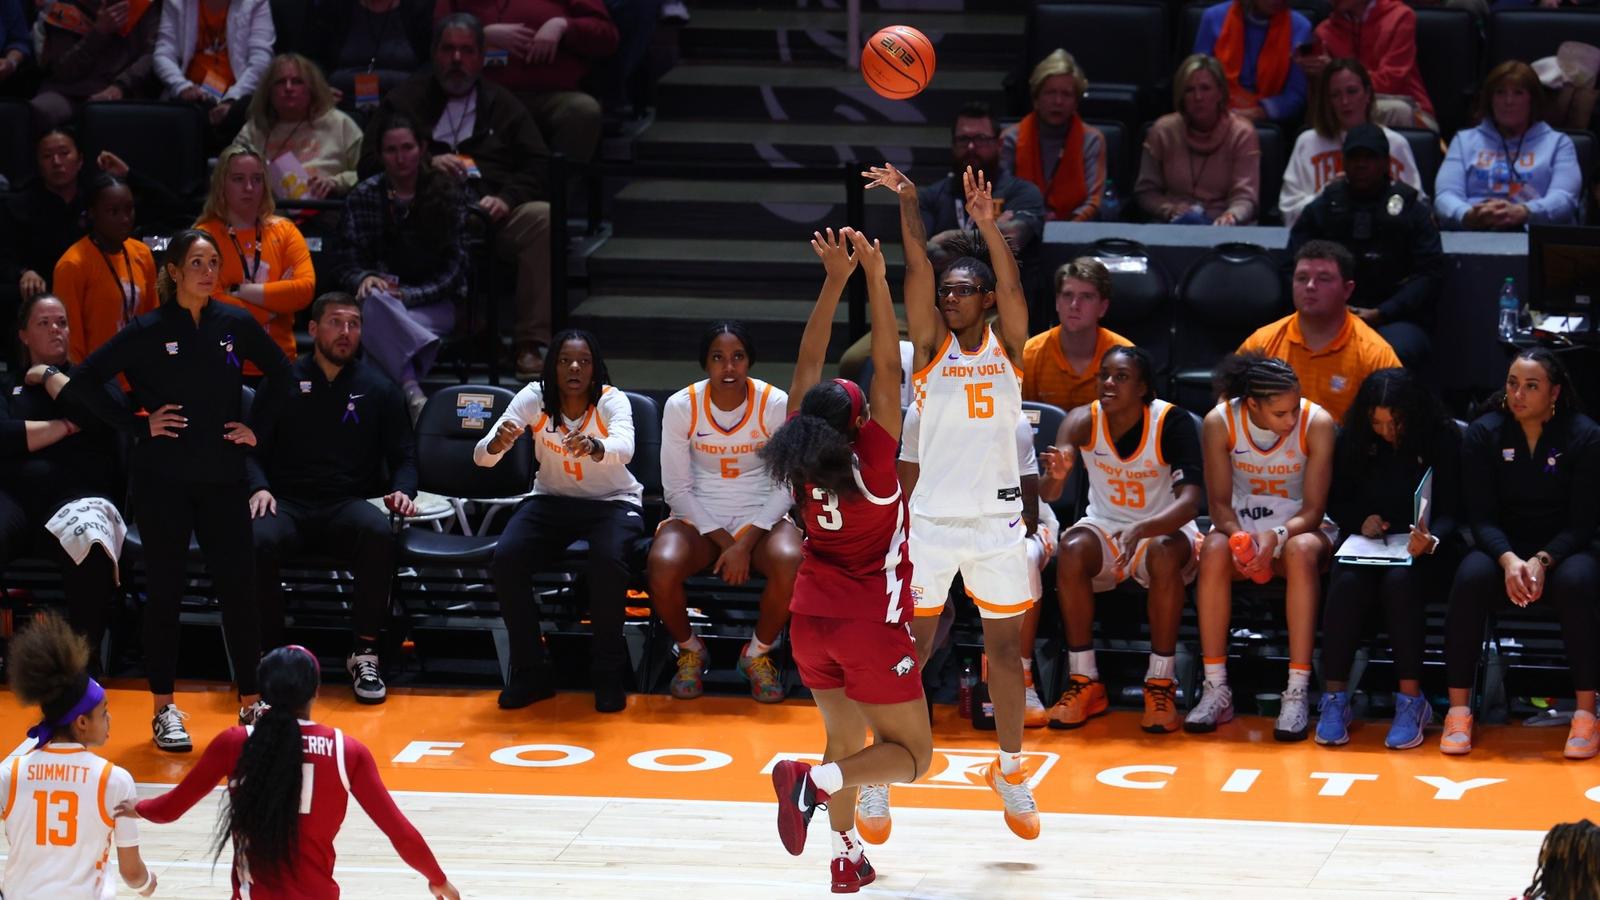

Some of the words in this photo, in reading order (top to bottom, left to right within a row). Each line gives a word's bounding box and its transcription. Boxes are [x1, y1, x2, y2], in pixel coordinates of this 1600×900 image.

[880, 36, 916, 67] ELITE
[942, 366, 974, 377] LADY
[964, 382, 995, 419] 15
[694, 441, 727, 455] LADY
[563, 461, 583, 481] 4
[720, 457, 742, 479] 5
[1094, 460, 1122, 477] LADY
[1126, 469, 1159, 479] VOLS
[1267, 462, 1301, 475] VOLS
[1107, 479, 1146, 509] 33
[1249, 479, 1289, 498] 25
[812, 487, 843, 531] 3
[73, 521, 111, 537] GATO
[27, 763, 90, 784] SUMMITT
[391, 740, 826, 775] FOO
[1095, 764, 1508, 800] CITY
[33, 790, 79, 847] 13
